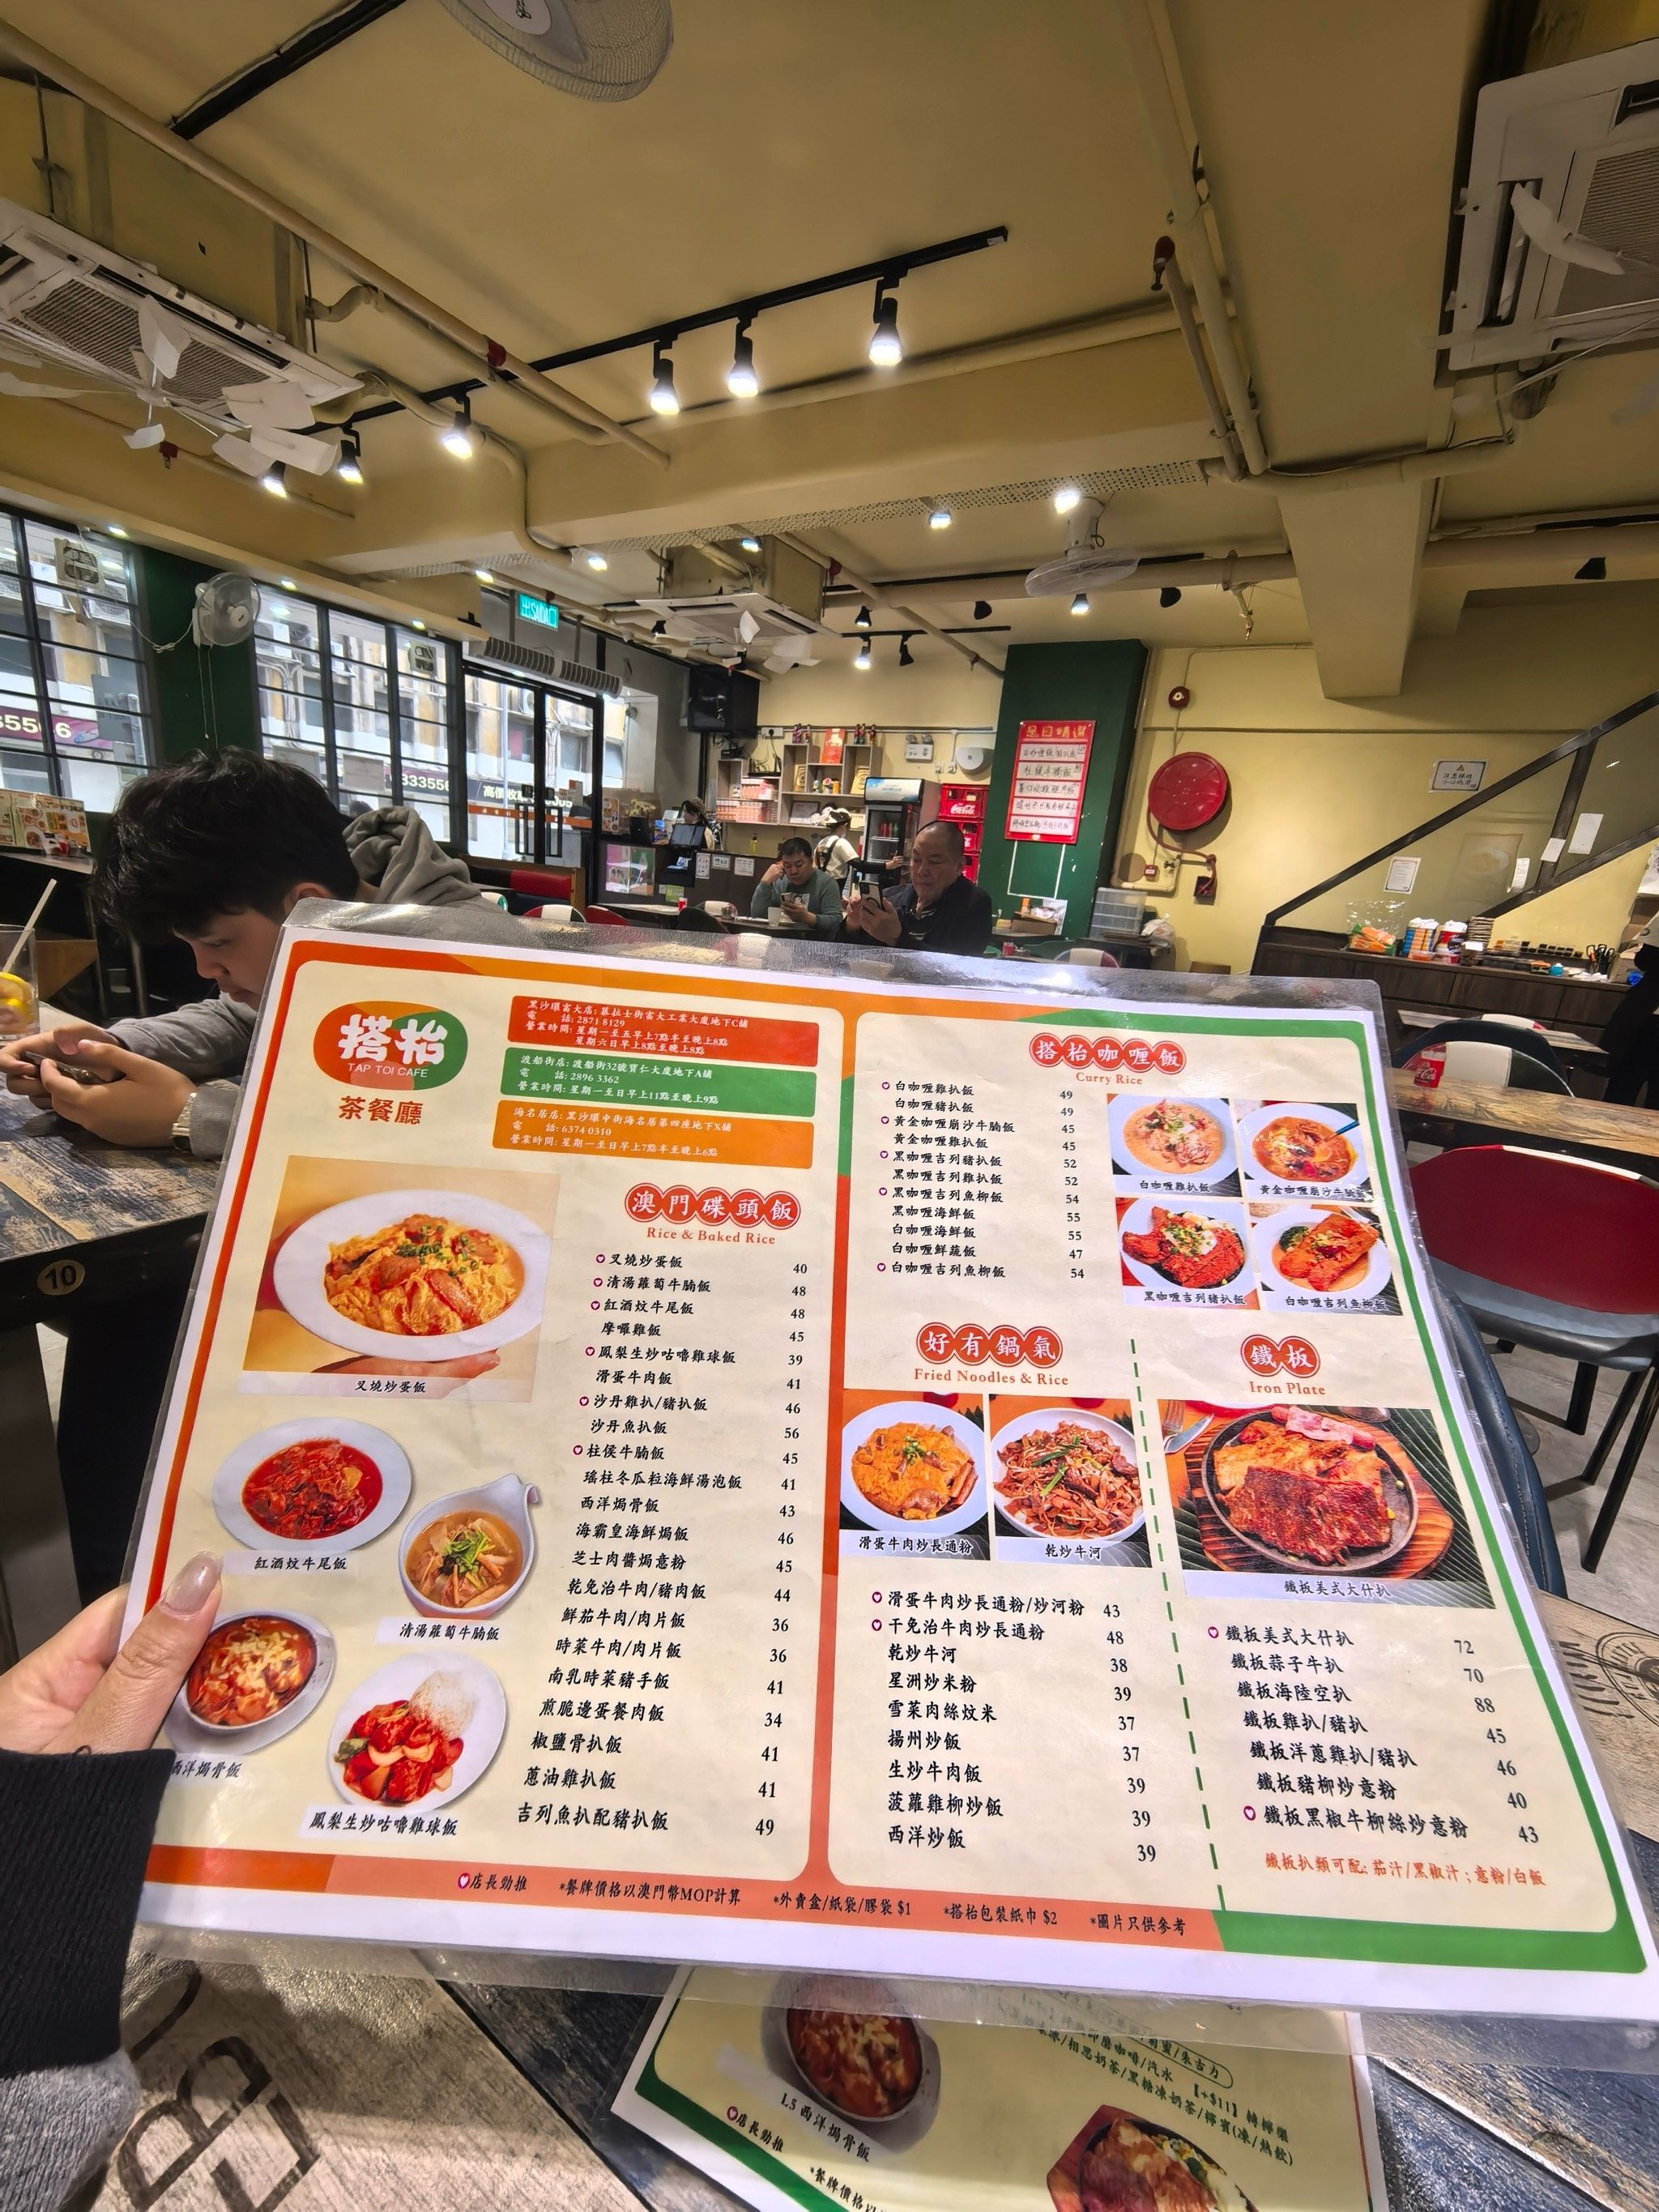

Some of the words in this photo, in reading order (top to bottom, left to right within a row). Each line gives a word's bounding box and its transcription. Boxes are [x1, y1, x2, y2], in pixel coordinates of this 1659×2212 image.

[577, 1015, 599, 1025] 2871
[603, 1018, 625, 1027] 8129
[338, 1014, 447, 1065] 搭枱
[1036, 1041, 1180, 1067] 搭枱咖喱飯
[348, 1063, 371, 1073] TAP
[375, 1065, 394, 1075] TOI
[398, 1067, 429, 1078] CAFE
[570, 1073, 594, 1082] 2896
[596, 1074, 620, 1084] 3362
[1076, 1072, 1112, 1085] Curry
[1115, 1074, 1143, 1085] Rice
[1060, 1091, 1073, 1100] 49
[338, 1095, 424, 1125] 茶餐廳
[1060, 1108, 1073, 1117] 49
[561, 1125, 585, 1134] 6374
[588, 1127, 612, 1136] 0310
[1061, 1125, 1075, 1134] 45
[1062, 1142, 1076, 1151] 45
[1064, 1159, 1077, 1168] 52
[1064, 1177, 1078, 1186] 52
[632, 1191, 794, 1221] 澳門碟頭飯
[1066, 1195, 1079, 1204] 54
[1067, 1213, 1081, 1222] 55
[647, 1228, 677, 1239] Rice
[682, 1230, 693, 1240] &
[698, 1231, 740, 1243] Baked
[745, 1232, 776, 1245] Rice
[1068, 1231, 1081, 1241] 55
[1069, 1249, 1083, 1259] 47
[793, 1264, 807, 1274] 40
[1071, 1269, 1085, 1279] 54
[45, 1265, 77, 1290] 10
[791, 1286, 806, 1296] 48
[791, 1309, 805, 1319] 48
[790, 1332, 804, 1342] 45
[924, 1332, 1056, 1360] 好有鍋氣
[788, 1355, 803, 1365] 39
[1250, 1344, 1314, 1369] 鐵板
[595, 1369, 672, 1385] 滑蛋牛肉飯
[787, 1378, 800, 1390] 41
[914, 1369, 952, 1381] Fried
[957, 1369, 1016, 1383] Noodles
[1021, 1373, 1032, 1384] &
[1038, 1373, 1068, 1386] Rice
[355, 1380, 426, 1393] 叉燒炒蛋飯
[1249, 1381, 1282, 1394] Iron
[1286, 1382, 1325, 1396] Plate
[785, 1403, 801, 1414] 46
[591, 1419, 667, 1435] 沙丹魚扒飯
[784, 1428, 799, 1439] 56
[783, 1453, 798, 1464] 45
[781, 1479, 795, 1490] 41
[581, 1496, 659, 1513] 西洋焗骨飯
[779, 1505, 795, 1518] 43
[778, 1533, 794, 1545] 46
[859, 1535, 973, 1554] 滑蛋牛肉炒長通粉
[1045, 1544, 1102, 1560] 乾炒牛河
[572, 1551, 687, 1570] 芝士肉醬焗意粉
[776, 1560, 792, 1573] 45
[774, 1589, 791, 1602] 44
[1103, 1604, 1120, 1618] 43
[772, 1618, 789, 1632] 36
[1107, 1631, 1124, 1645] 48
[1454, 1640, 1474, 1654] 72
[770, 1649, 787, 1663] 36
[888, 1643, 957, 1663] 乾炒牛河
[1110, 1659, 1128, 1672] 38
[548, 1667, 669, 1689] 南乳時菜豬手飯
[767, 1680, 783, 1694] 41
[1464, 1668, 1484, 1683] 70
[888, 1672, 977, 1693] 星洲炒米粉
[1114, 1686, 1132, 1702] 39
[1474, 1697, 1495, 1713] 88
[764, 1713, 782, 1727] 34
[1118, 1716, 1135, 1731] 37
[1486, 1728, 1506, 1744] 45
[888, 1729, 962, 1751] 揚州炒飯
[1123, 1746, 1140, 1761] 37
[761, 1747, 778, 1761] 41
[1497, 1759, 1516, 1777] 46
[888, 1759, 983, 1783] 生炒牛肉飯
[1128, 1777, 1145, 1793] 39
[758, 1782, 776, 1798] 41
[1508, 1792, 1527, 1809] 40
[518, 1801, 668, 1831] 吉列魚扒配豬扒飯
[756, 1819, 774, 1835] 49
[1132, 1811, 1151, 1827] 39
[1519, 1826, 1539, 1843] 43
[888, 1825, 966, 1849] 西洋炒飯
[1137, 1844, 1156, 1862] 39
[470, 1872, 527, 1892] 店長勁推
[898, 1901, 911, 1915] $1
[1043, 1911, 1057, 1925] $2
